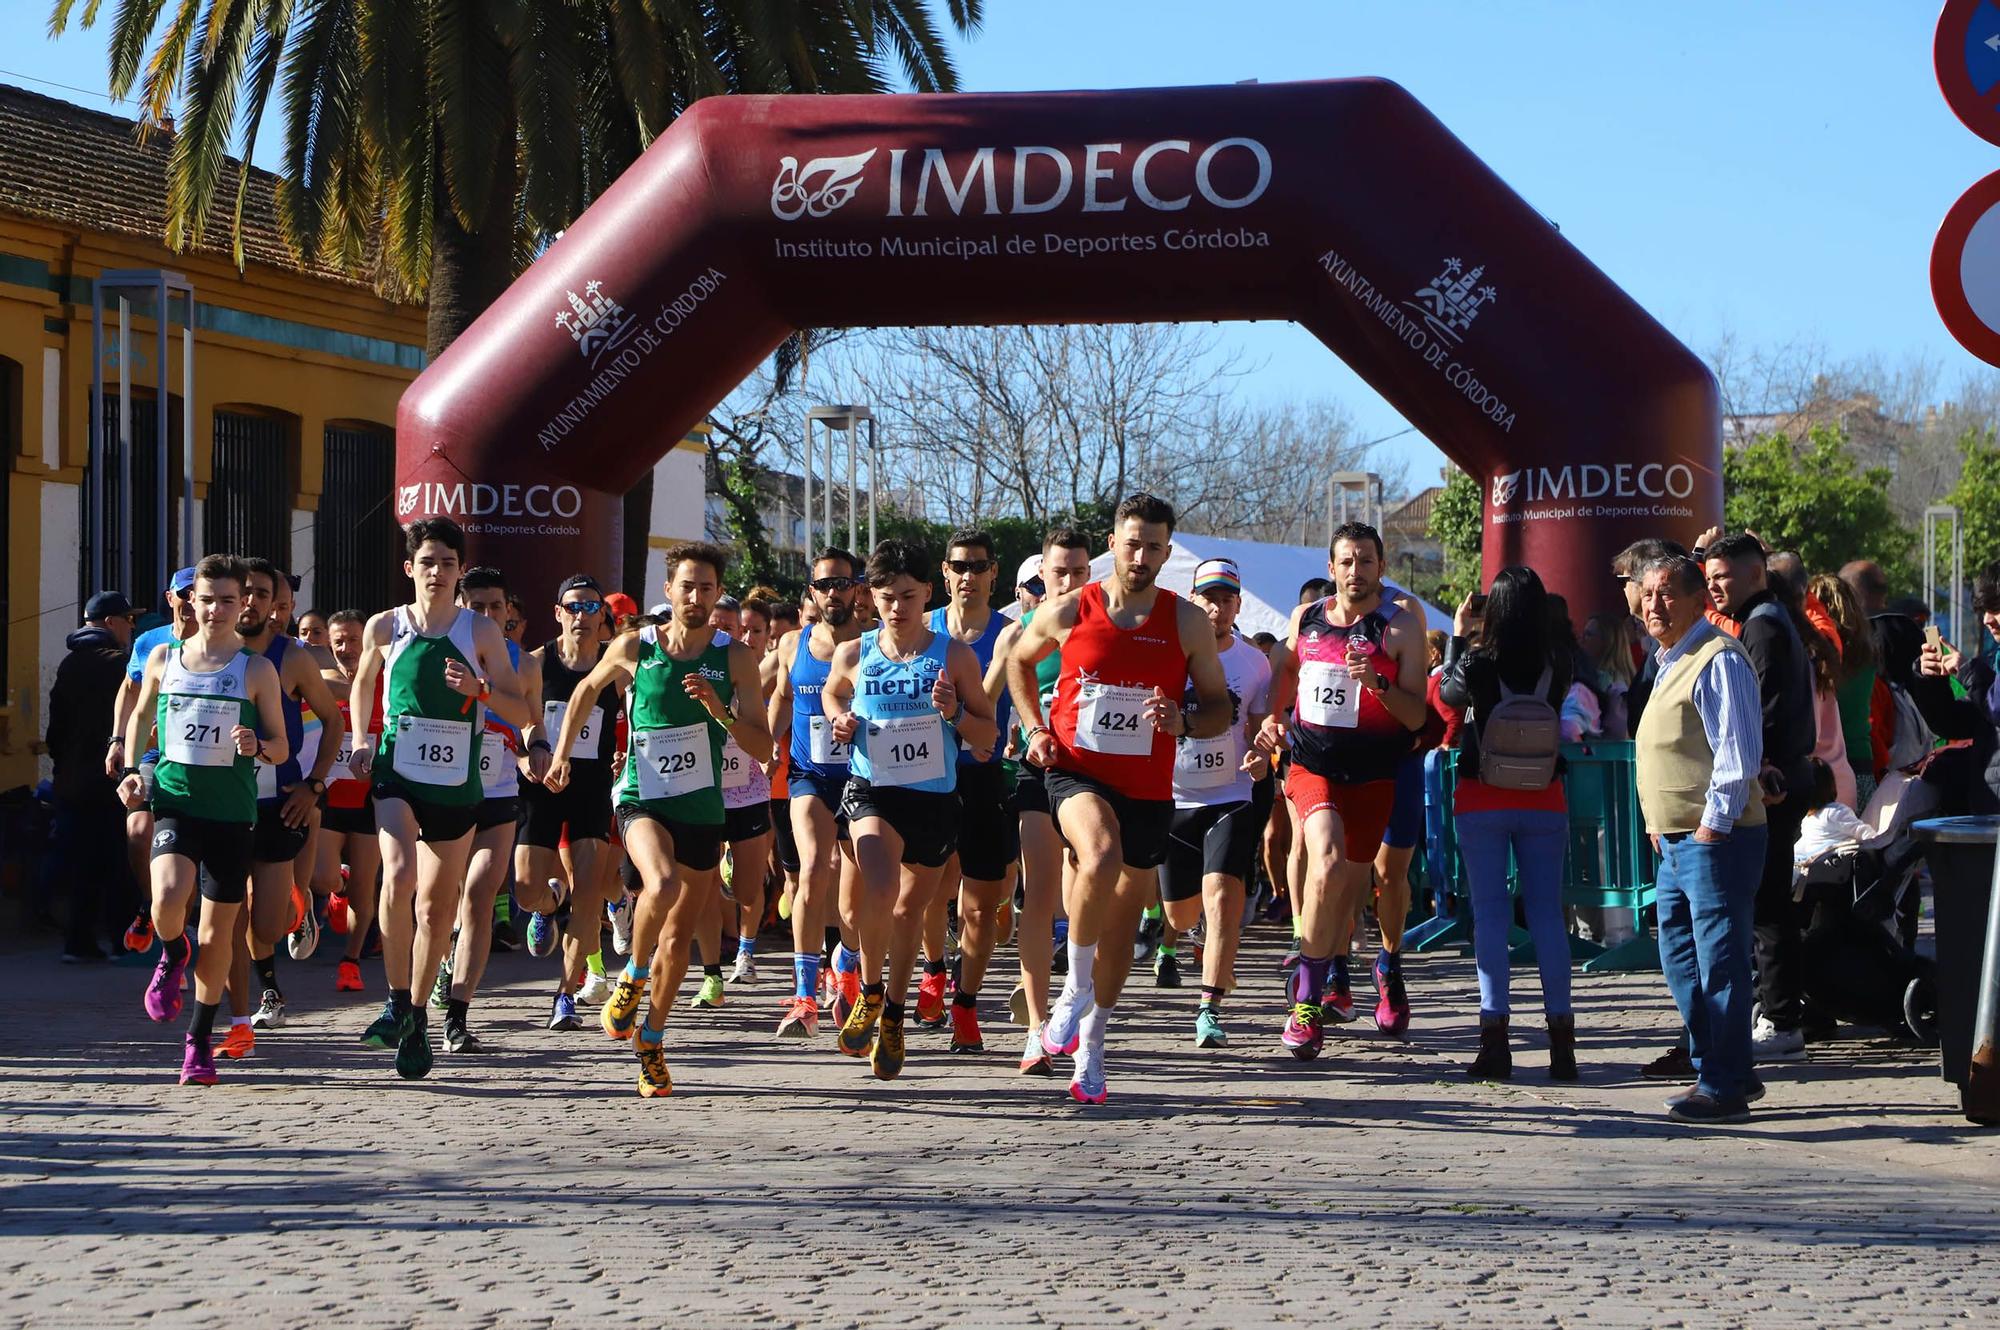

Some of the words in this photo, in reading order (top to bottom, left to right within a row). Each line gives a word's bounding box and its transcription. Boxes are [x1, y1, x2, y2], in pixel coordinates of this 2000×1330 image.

[885, 136, 1273, 217] IMDECO
[775, 237, 873, 258] Instituto
[880, 234, 998, 261] Municipal
[1006, 233, 1036, 254] de
[1044, 231, 1156, 260] Deportes
[1163, 227, 1270, 251] Córdoba
[1317, 248, 1428, 351] AYUNTAMIENTO
[1422, 341, 1452, 371] DE
[1444, 367, 1517, 433] CÓRDOBA
[537, 345, 641, 452] AYUNTAMIENTO
[636, 329, 663, 356] DE
[654, 266, 727, 336] CÓRDOBA
[1526, 463, 1694, 502] IMDECO
[424, 482, 582, 518] IMDECO
[1523, 505, 1575, 521] Municipal
[1577, 505, 1593, 516] de
[1596, 505, 1649, 519] Deportes
[1652, 504, 1693, 517] Córdoba
[468, 524, 482, 533] de
[485, 524, 535, 536] Deportes
[538, 524, 580, 536] Córdoba
[799, 685, 823, 695] TROT
[865, 673, 935, 699] nerja
[1313, 686, 1346, 706] 125
[877, 701, 928, 712] ATLETISMO
[1098, 711, 1139, 731] 424
[184, 724, 221, 744] 271
[418, 743, 454, 763] 183
[658, 751, 696, 774] 229
[890, 741, 929, 763] 104
[1194, 752, 1225, 769] 195
